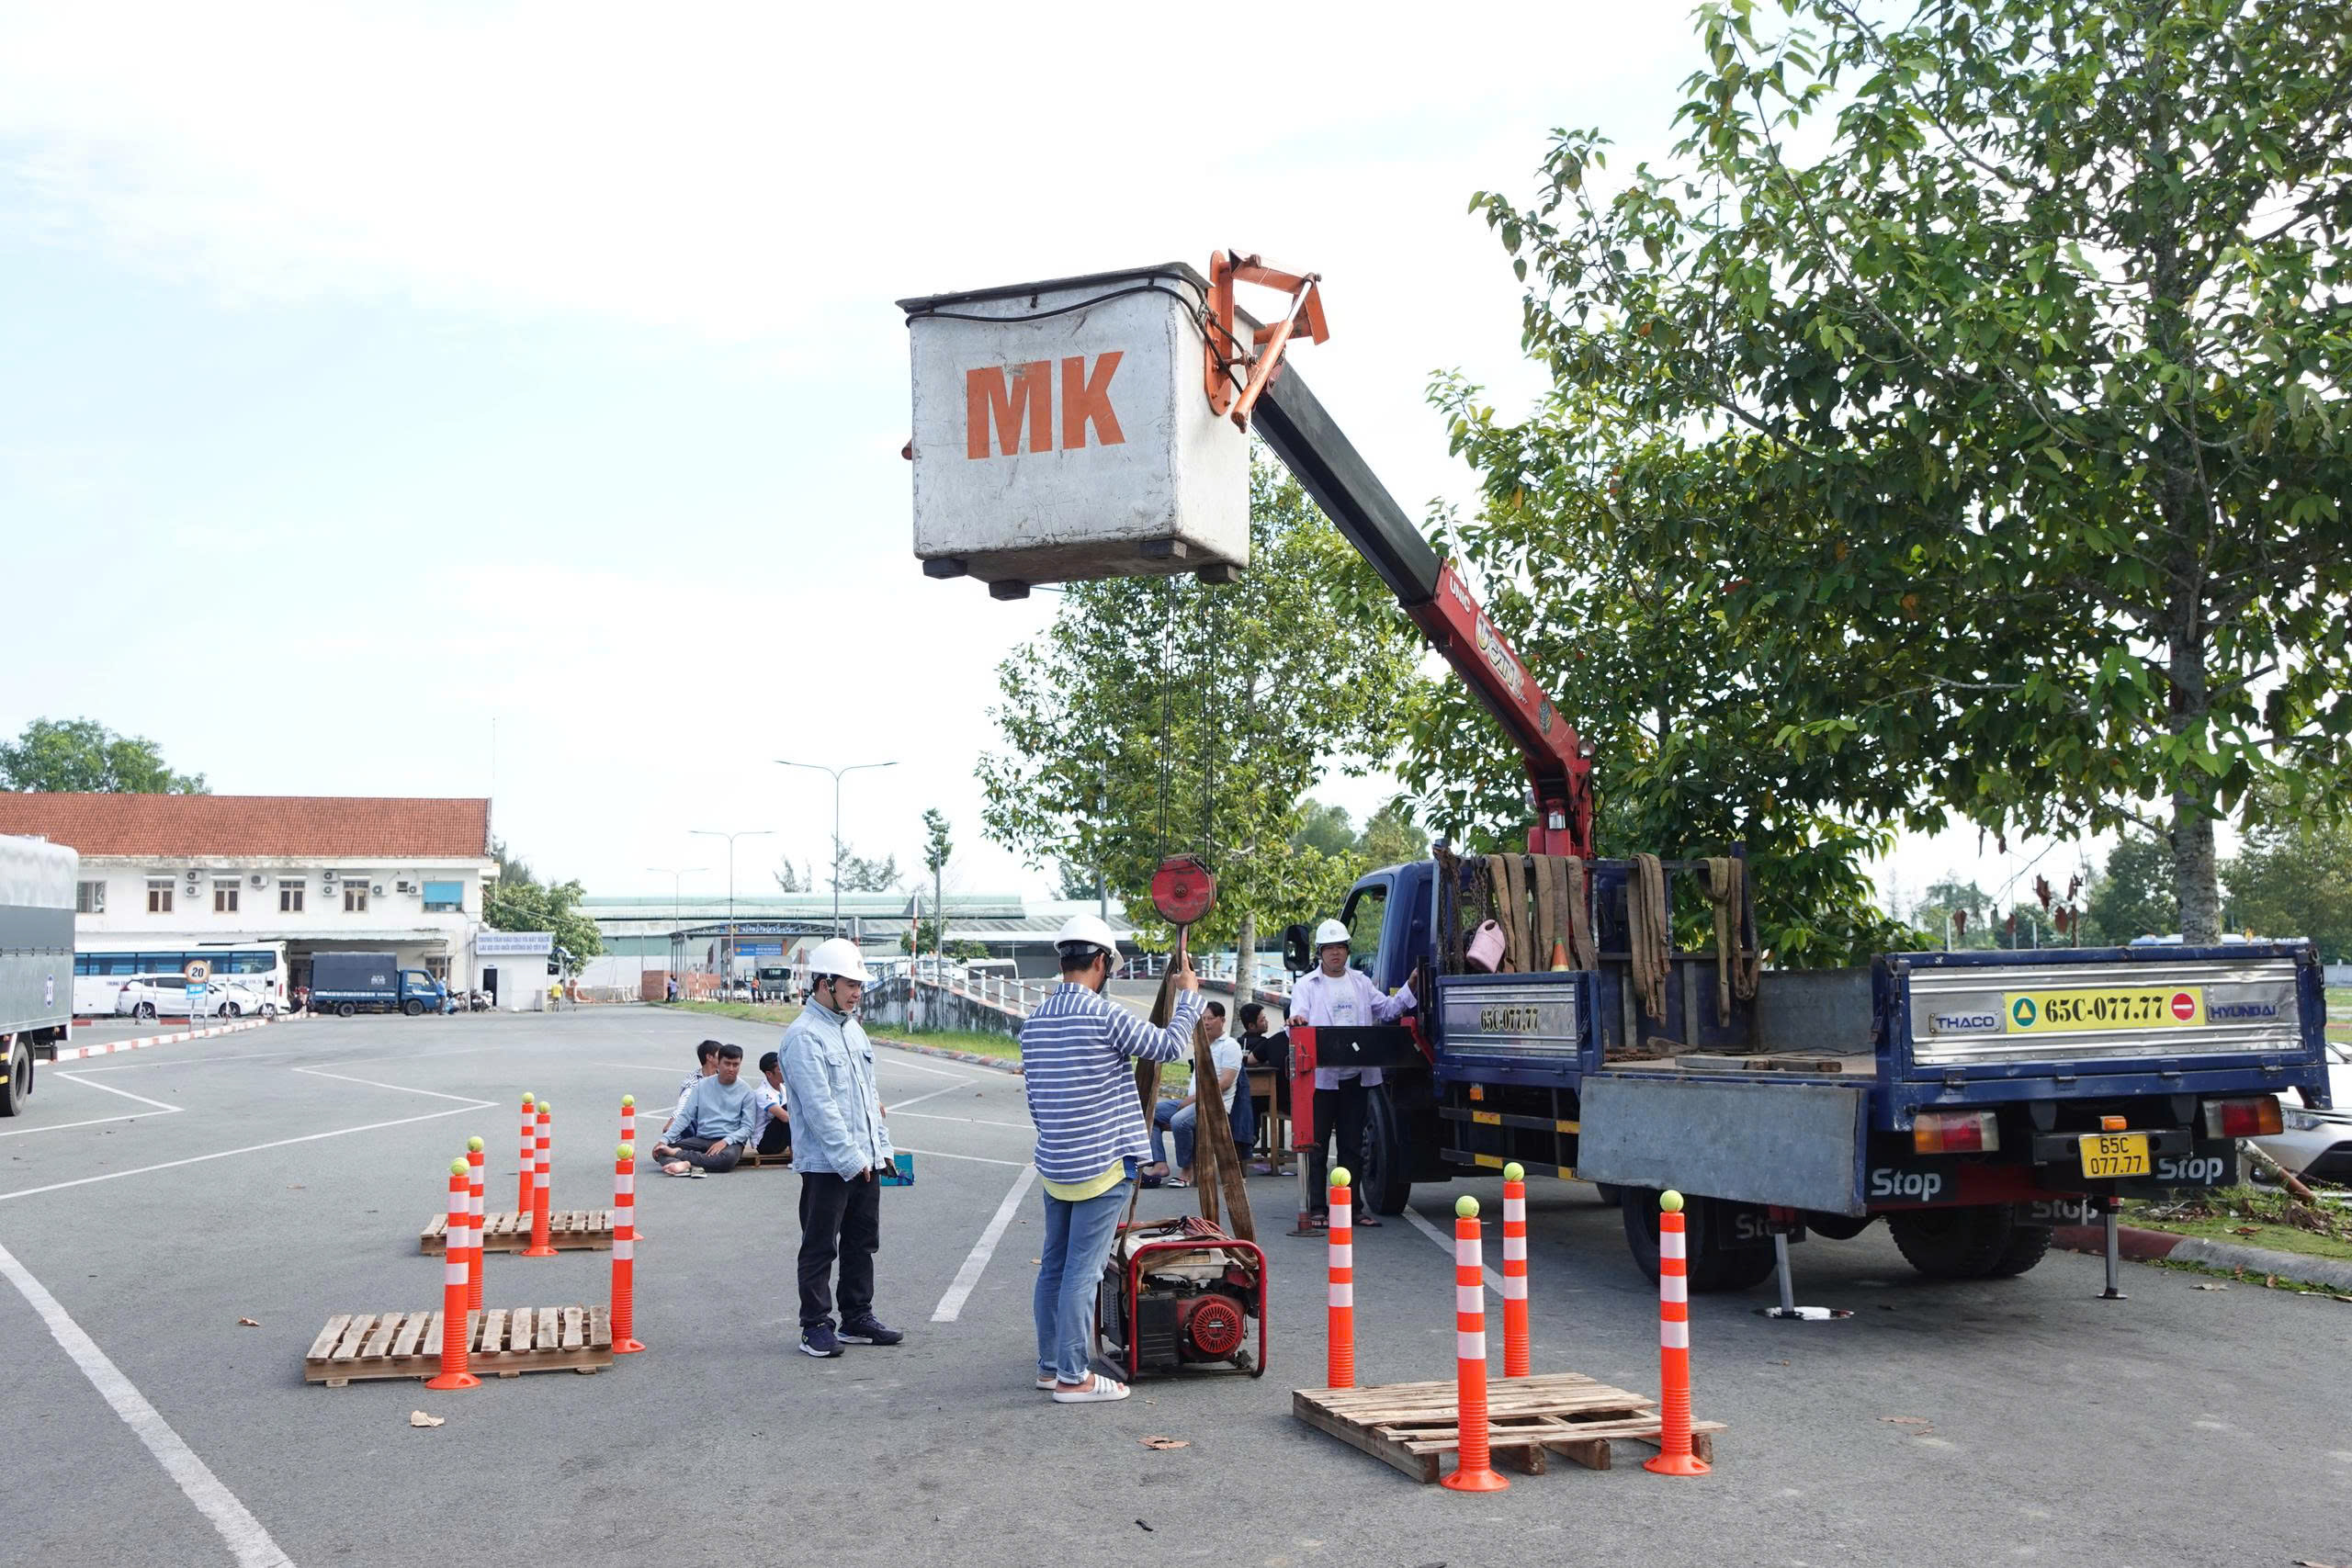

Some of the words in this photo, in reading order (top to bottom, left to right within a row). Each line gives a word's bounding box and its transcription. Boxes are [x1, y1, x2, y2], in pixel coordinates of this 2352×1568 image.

[967, 351, 1125, 459] MK
[1449, 576, 1471, 614] UNIC
[191, 967, 204, 977] 20
[1480, 1009, 1539, 1031] 65C-077.77
[2045, 997, 2164, 1022] 65C-077.77
[2211, 1005, 2276, 1019] HYUNDAI
[1935, 1016, 1995, 1029] THACO
[2100, 1137, 2130, 1154] 65C
[2090, 1156, 2142, 1175] 077.77
[2156, 1157, 2223, 1185] Stop
[1871, 1168, 1941, 1201] Stop
